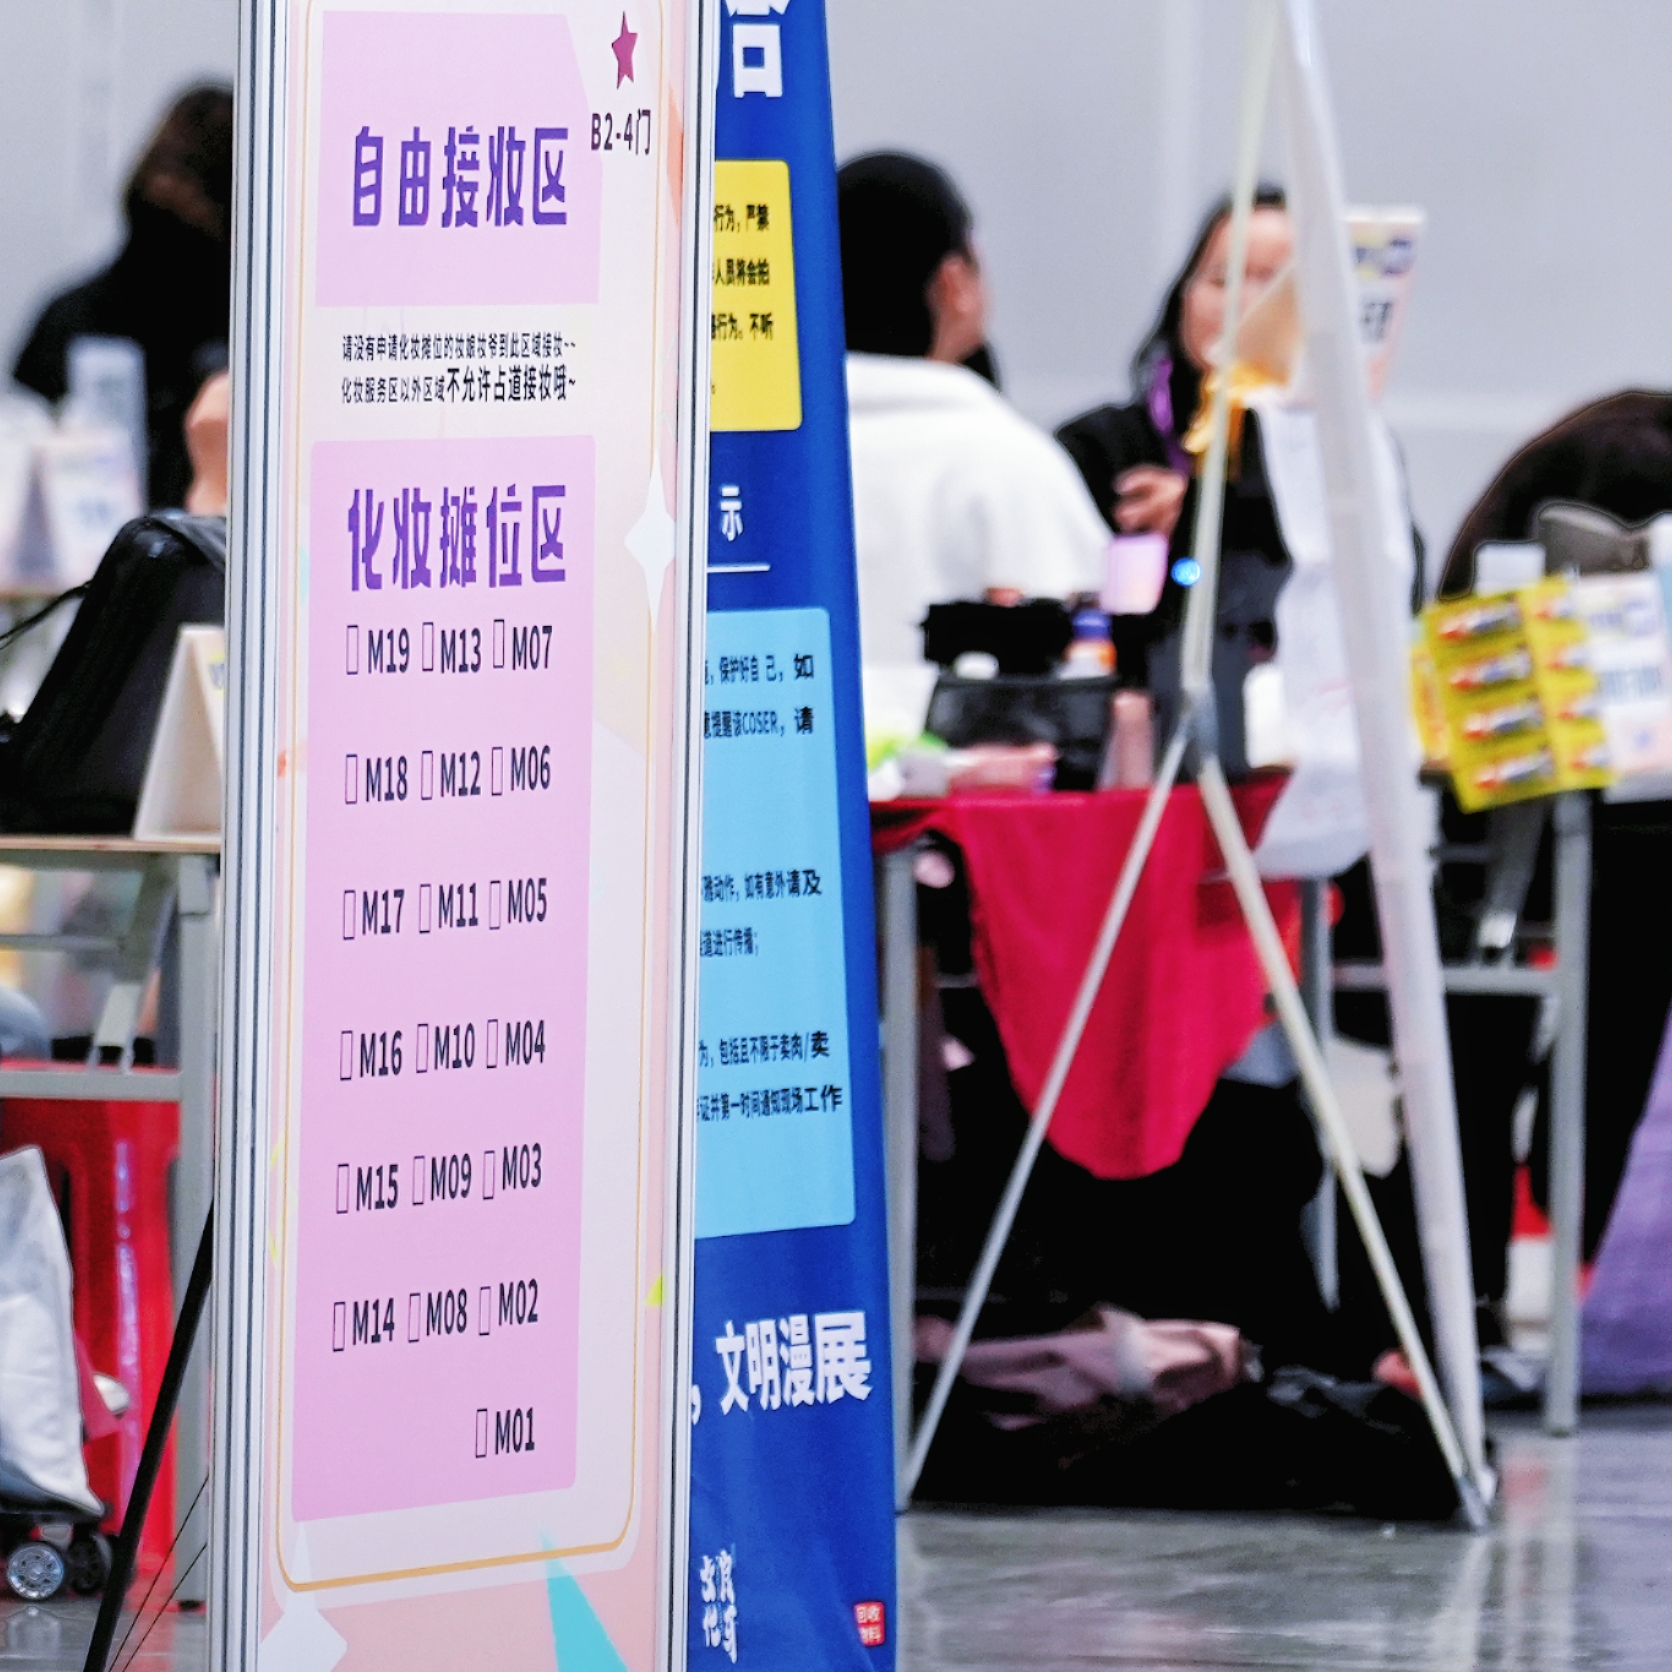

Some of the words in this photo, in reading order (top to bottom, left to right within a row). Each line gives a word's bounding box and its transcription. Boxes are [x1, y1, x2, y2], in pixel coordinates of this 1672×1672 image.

[591, 108, 651, 155] B2-4门
[352, 125, 568, 227] 自由接妆区
[347, 483, 566, 592] 化妆摊位区
[368, 629, 410, 674] M19
[440, 628, 482, 673] M13
[512, 626, 553, 670] M07
[365, 756, 408, 801] M18
[440, 752, 481, 797] M12
[510, 746, 551, 790] M06
[362, 889, 405, 935] M17
[438, 884, 479, 928] M11
[508, 879, 547, 923] M05
[359, 1031, 403, 1077] M16
[434, 1025, 475, 1069] M10
[505, 1021, 546, 1065] M04
[697, 1085, 843, 1122] 证并第一时间通知现场工作
[356, 1165, 399, 1211] M15
[430, 1154, 472, 1202] M09
[502, 1144, 542, 1190] M03
[352, 1299, 396, 1346] M14
[426, 1290, 467, 1337] M08
[498, 1279, 539, 1327] M02
[495, 1408, 535, 1455] M01
